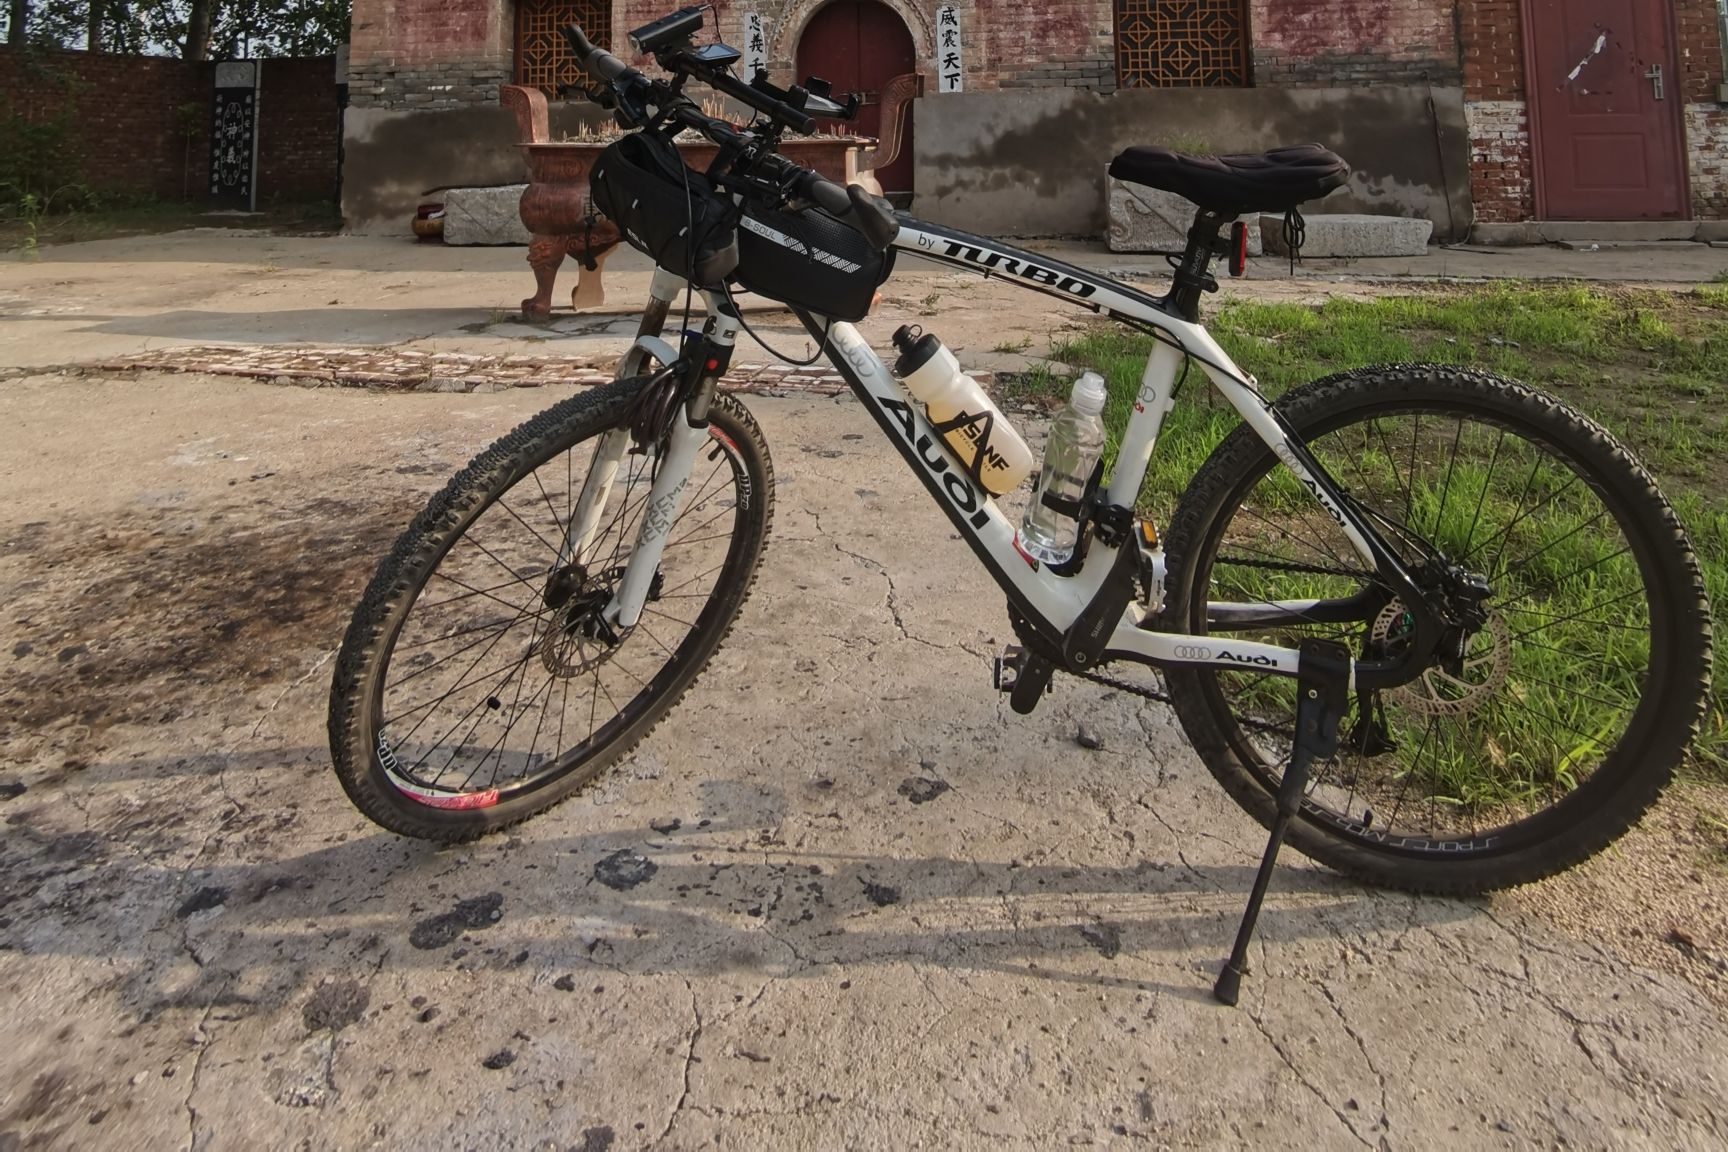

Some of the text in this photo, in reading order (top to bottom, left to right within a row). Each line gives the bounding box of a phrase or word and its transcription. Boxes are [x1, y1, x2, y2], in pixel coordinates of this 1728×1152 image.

[940, 6, 961, 90] 威震天下
[918, 234, 1097, 298] by TURBO
